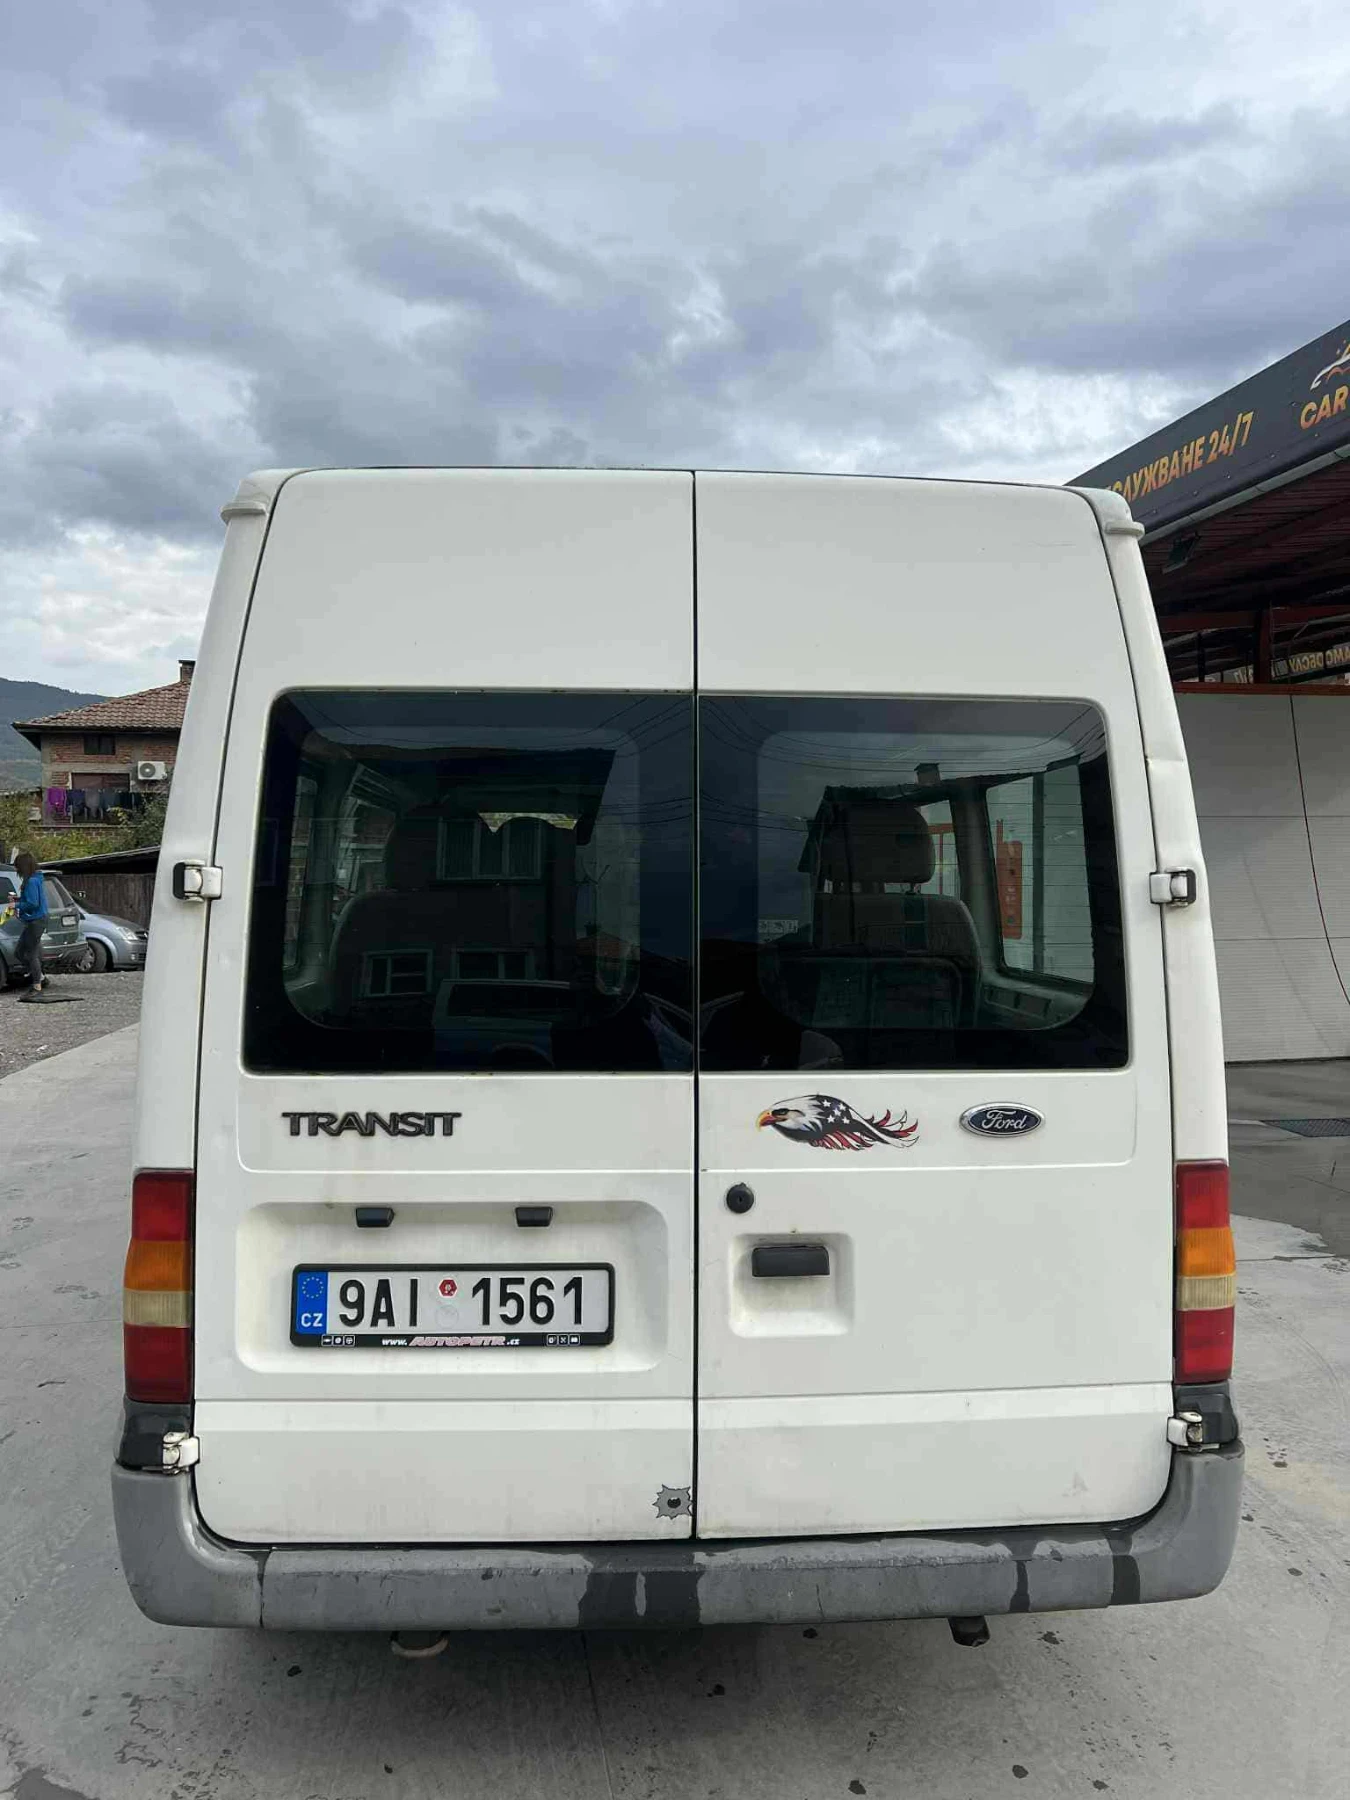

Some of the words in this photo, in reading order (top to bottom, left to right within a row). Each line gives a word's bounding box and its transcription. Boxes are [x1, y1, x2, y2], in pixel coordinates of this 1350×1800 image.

[1300, 385, 1348, 430] CAR
[1106, 436, 1205, 502] СЛУЖВАНЕ
[1205, 411, 1253, 464] 24/7
[281, 1111, 462, 1137] TRANSIT
[981, 1110, 1027, 1129] Ford
[339, 1279, 417, 1327] 9AI
[471, 1276, 584, 1327] 1561
[300, 1313, 323, 1328] CZ
